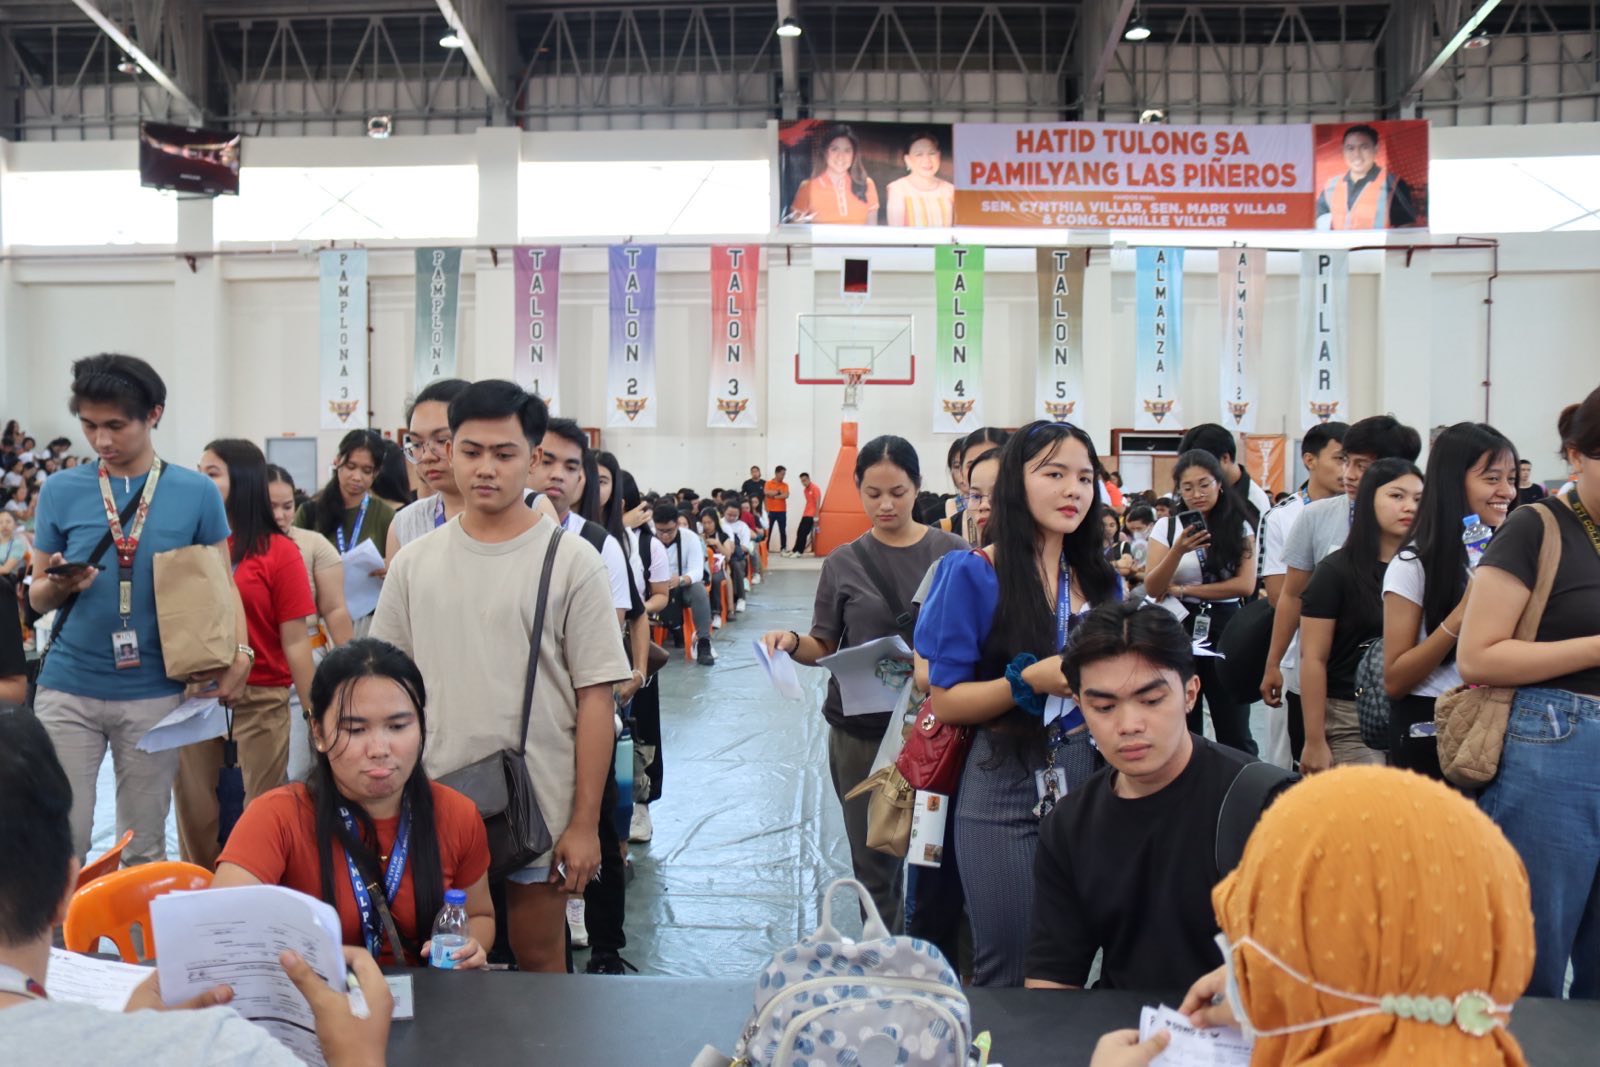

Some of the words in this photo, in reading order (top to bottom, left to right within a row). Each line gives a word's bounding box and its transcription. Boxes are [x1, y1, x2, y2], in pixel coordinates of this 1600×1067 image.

[1016, 129, 1096, 154] HATID
[1102, 130, 1208, 155] TULONG
[1214, 131, 1250, 155] SA
[970, 161, 1120, 186] PAMILYANG
[1126, 162, 1176, 187] LAS
[1183, 157, 1298, 188] PIÑEROS
[981, 201, 1016, 213] SEN.
[1018, 201, 1086, 213] CYNTHIA
[1089, 201, 1147, 215] VILLAR,
[1150, 202, 1184, 214] SEN.
[1187, 203, 1230, 214] MARK
[1233, 203, 1287, 215] VILLAR
[1042, 214, 1053, 225] &
[1056, 214, 1104, 226] CONG.
[1106, 214, 1170, 227] CAMILLE
[1173, 215, 1228, 227] VILLAR
[338, 253, 350, 378] PAMPLONA
[431, 250, 445, 376] PAMPLONA
[529, 249, 545, 363] TALON
[625, 249, 641, 363] TALON
[726, 249, 743, 363] TALON
[952, 249, 968, 365] TALON
[1053, 252, 1069, 366] TALON
[1155, 250, 1167, 374] ALMANZA
[1317, 254, 1331, 391] PILAR
[340, 386, 349, 399] 3
[626, 379, 638, 396] 2
[728, 379, 739, 396] 3
[953, 380, 965, 397] 4
[1056, 382, 1067, 399] 5
[1156, 384, 1163, 399] 1
